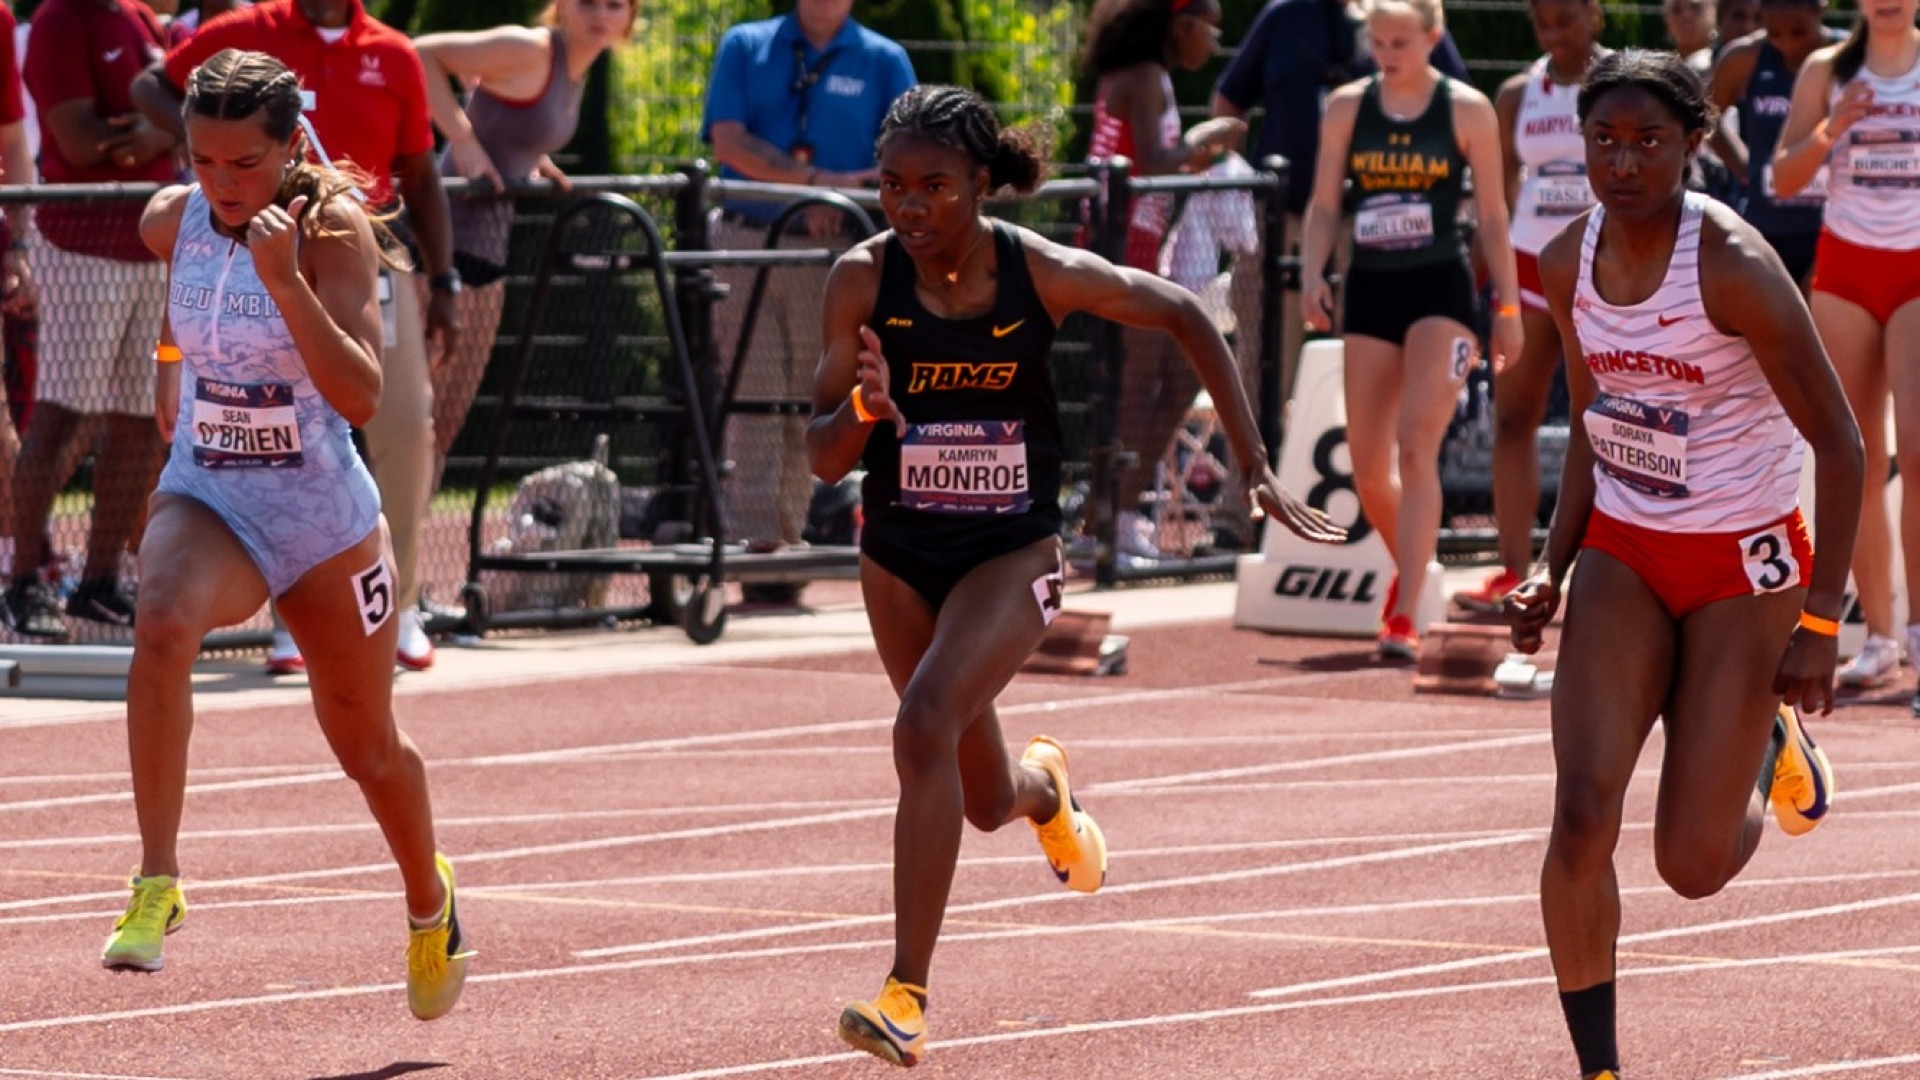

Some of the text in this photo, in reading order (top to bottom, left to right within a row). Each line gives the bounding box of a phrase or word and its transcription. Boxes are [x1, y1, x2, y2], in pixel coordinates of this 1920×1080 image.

[1353, 151, 1449, 177] WILLIAM
[1360, 216, 1431, 236] MELLOW
[1455, 342, 1470, 377] 8
[908, 362, 1018, 393] RAMS
[222, 408, 252, 423] SEAN
[198, 422, 295, 452] O'BRIEN
[916, 424, 986, 437] VIRGINIA
[1612, 422, 1654, 446] SORAYA
[938, 448, 998, 462] KAMRYN
[907, 464, 1025, 491] MONROE
[1307, 426, 1373, 545] 8
[1749, 533, 1790, 590] 3
[360, 563, 390, 625] 5
[1274, 566, 1378, 603] GILL
